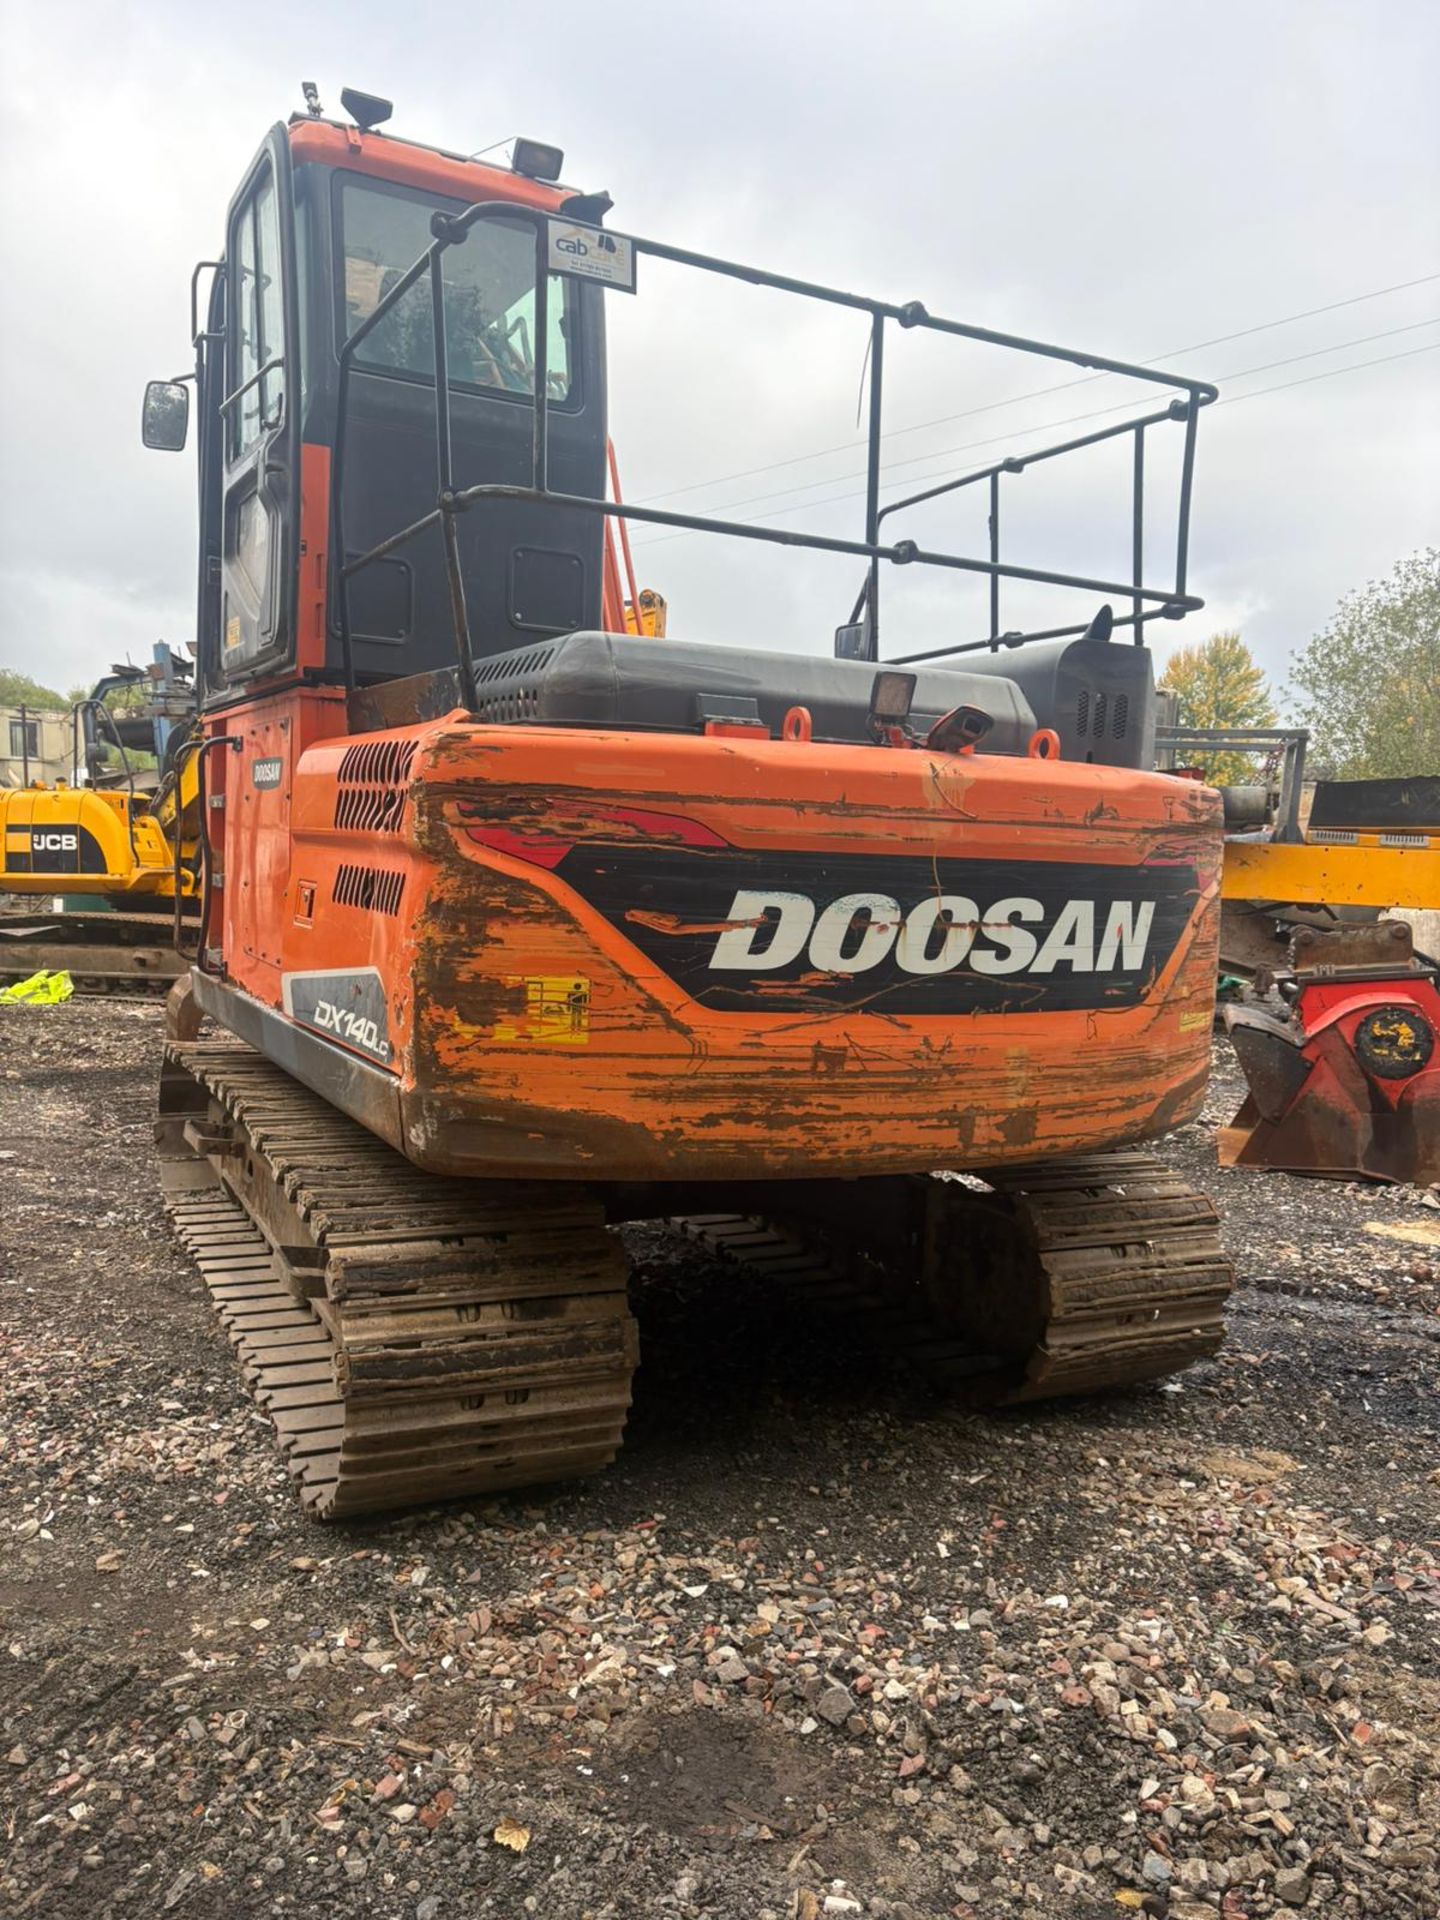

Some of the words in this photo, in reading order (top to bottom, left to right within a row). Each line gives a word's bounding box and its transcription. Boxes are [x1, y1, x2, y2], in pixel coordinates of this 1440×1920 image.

[254, 762, 281, 782] DOOSAN
[33, 834, 77, 851] JCB
[708, 889, 1156, 974] DOOSAN
